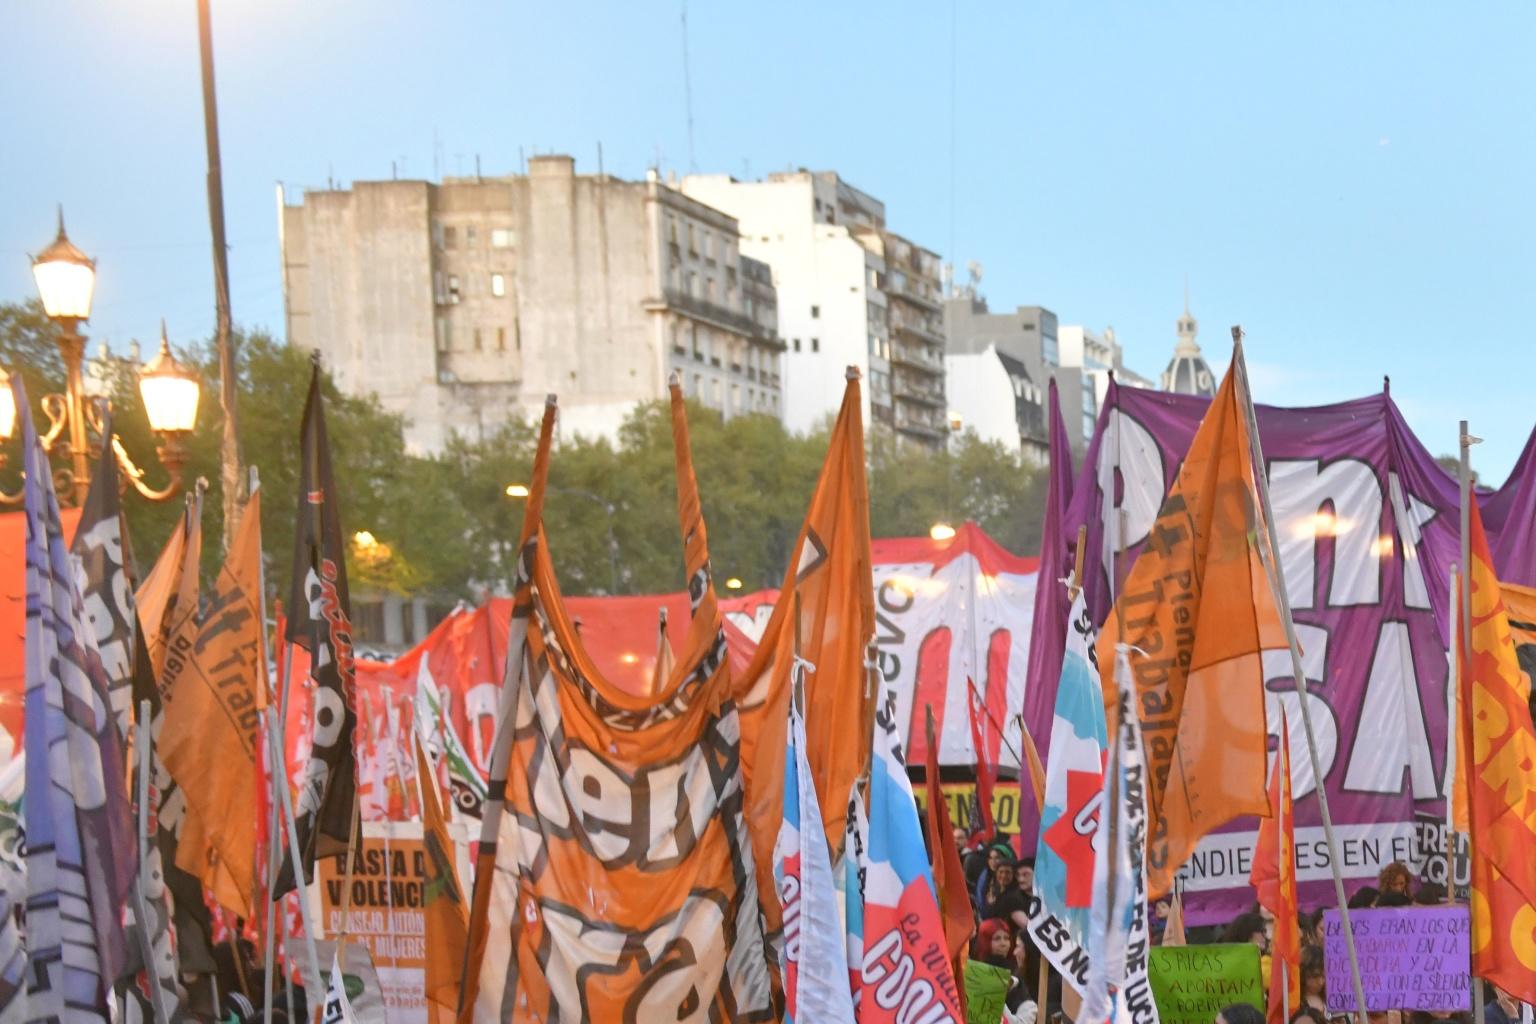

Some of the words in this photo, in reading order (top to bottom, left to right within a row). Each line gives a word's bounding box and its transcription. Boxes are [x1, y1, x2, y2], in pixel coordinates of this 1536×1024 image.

[1344, 839, 1380, 866] EN
[327, 879, 425, 909] VOLENCI
[330, 911, 384, 934] CNSEJO
[899, 911, 921, 948] La
[1379, 918, 1417, 935] ERAN
[1420, 918, 1444, 934] LOS
[1447, 917, 1469, 936] QUE
[1416, 938, 1435, 954] EN
[1442, 938, 1458, 954] LA
[1176, 951, 1223, 973] RICAS
[1410, 956, 1420, 973] Y
[1169, 977, 1255, 995] ABORTAN
[1416, 993, 1461, 1009] ESTADO
